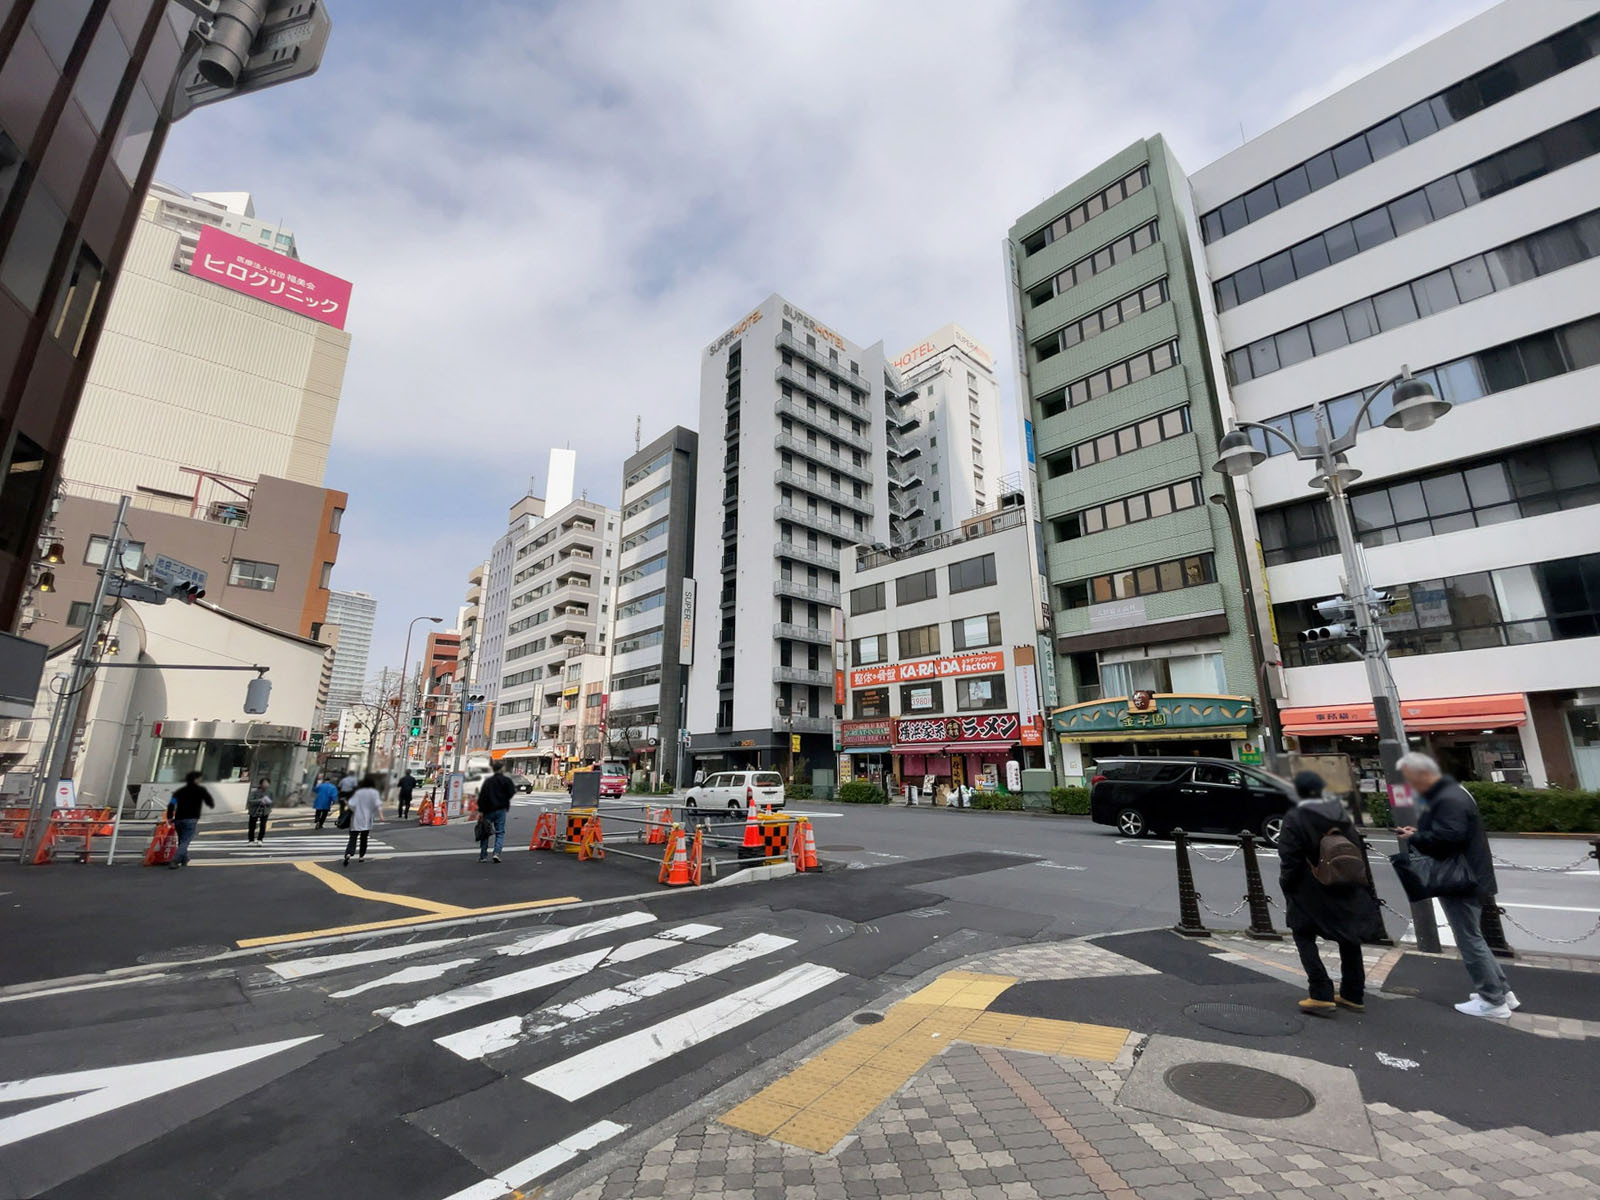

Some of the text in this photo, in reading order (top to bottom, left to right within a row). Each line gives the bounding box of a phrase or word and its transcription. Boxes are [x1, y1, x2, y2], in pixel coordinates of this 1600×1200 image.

[203, 253, 339, 313] ヒロクリニック
[961, 661, 998, 672] factory
[961, 715, 1018, 739] ラーメン
[1121, 713, 1167, 727] 金子園
